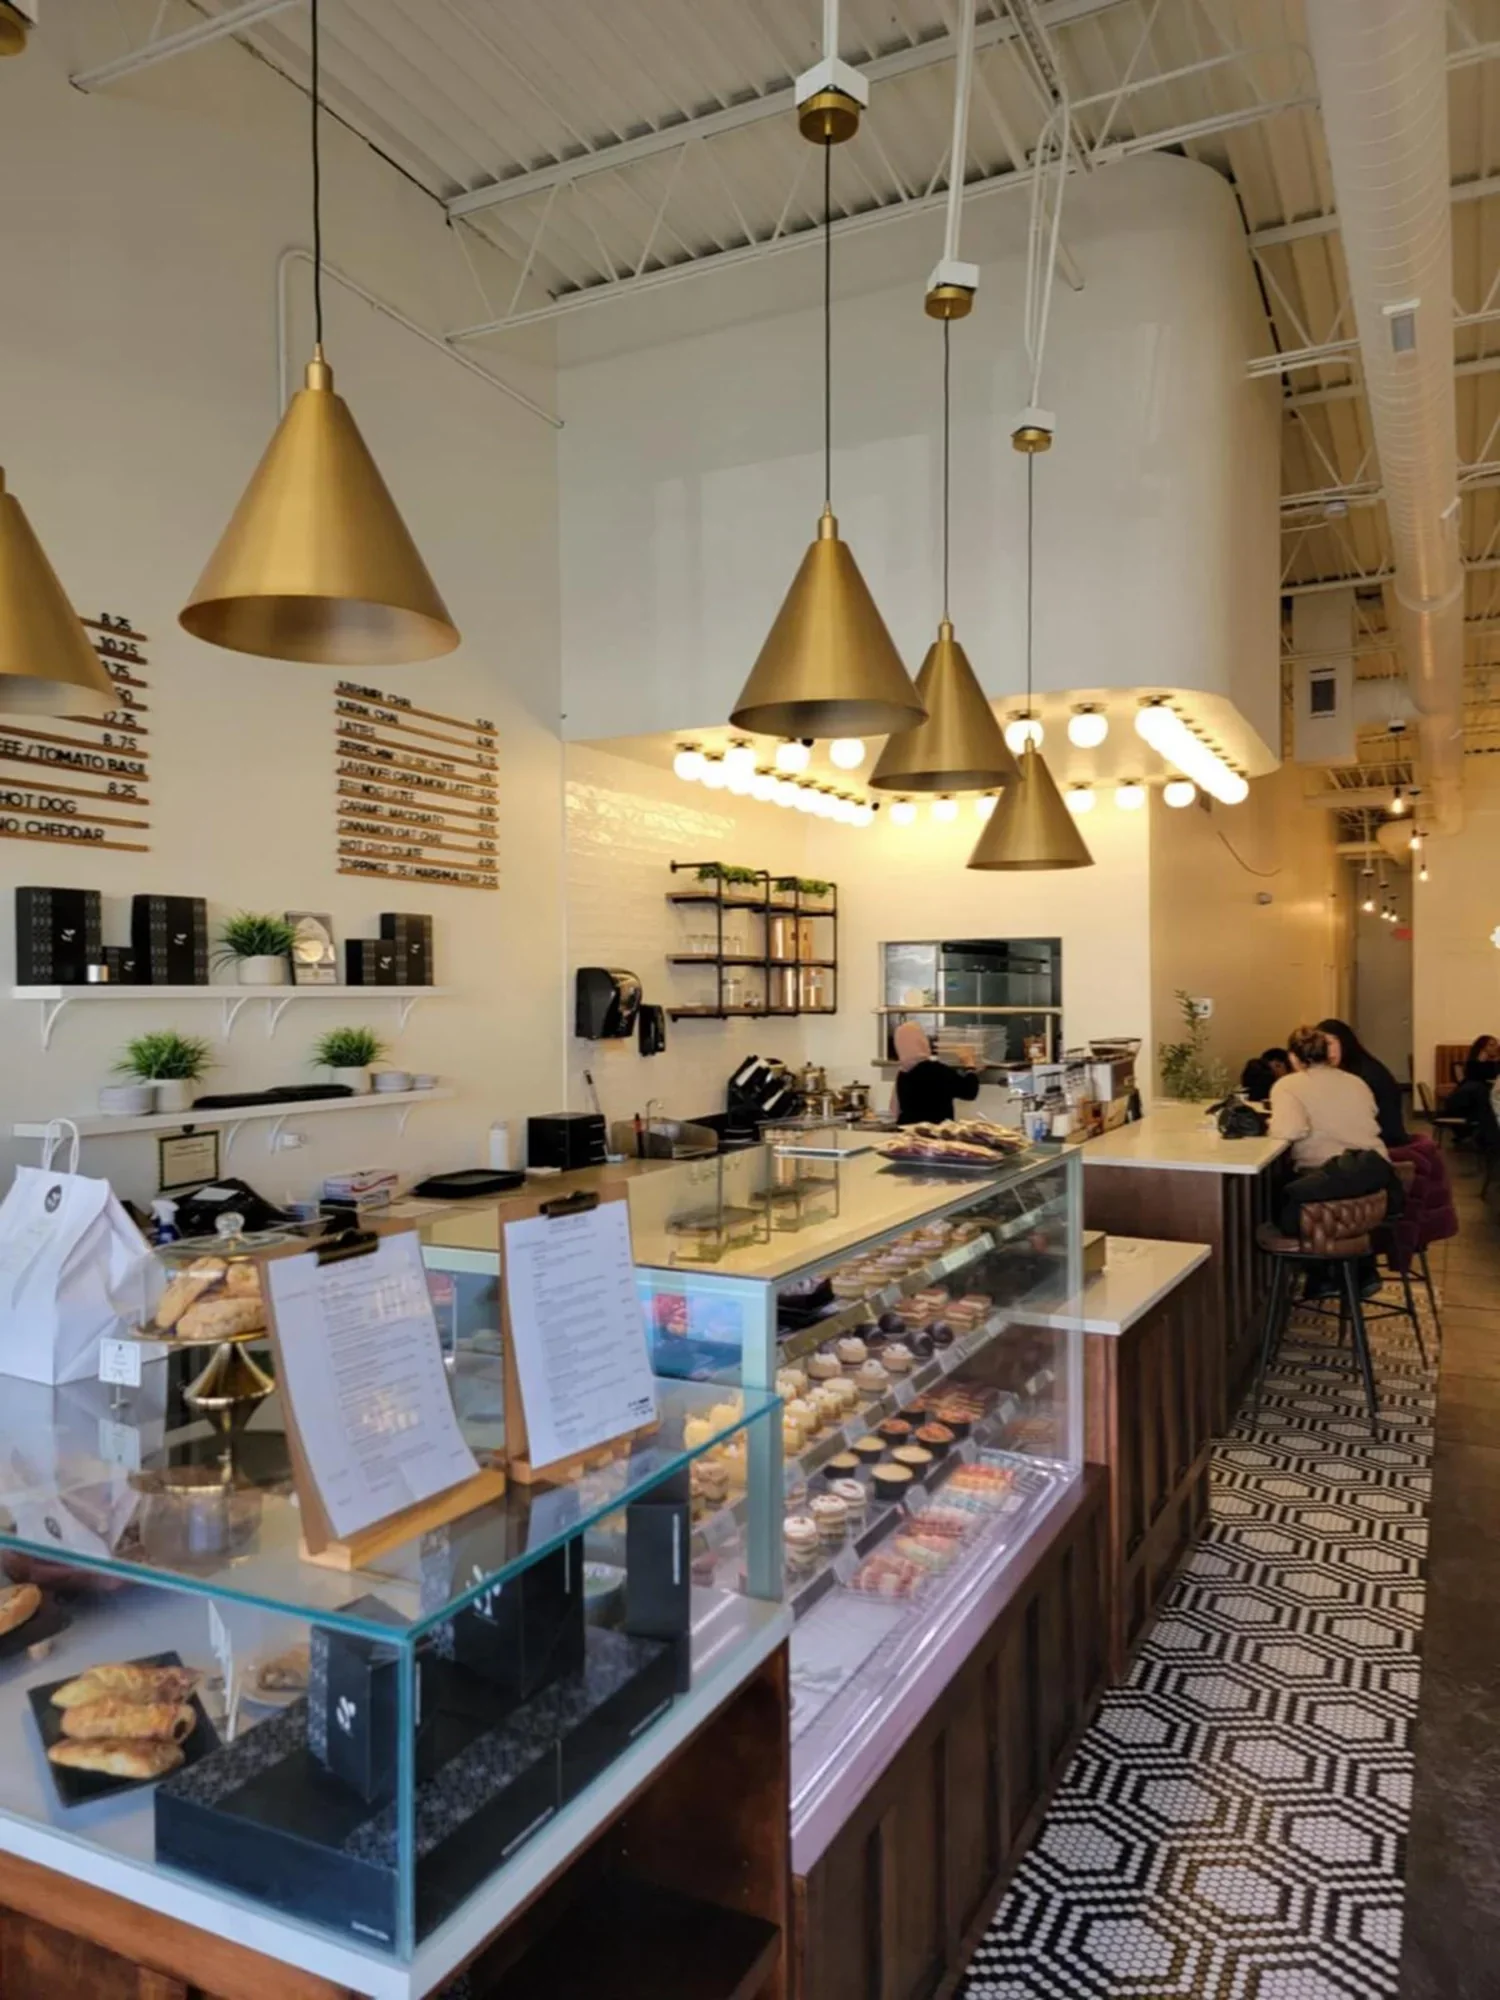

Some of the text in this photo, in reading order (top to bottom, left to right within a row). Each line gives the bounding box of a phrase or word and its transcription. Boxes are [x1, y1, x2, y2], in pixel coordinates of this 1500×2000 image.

[37, 744, 104, 770] TOMATO
[340, 759, 391, 779] LAVENDER
[39, 796, 77, 815] DOG
[24, 820, 105, 841] CHEDDAR
